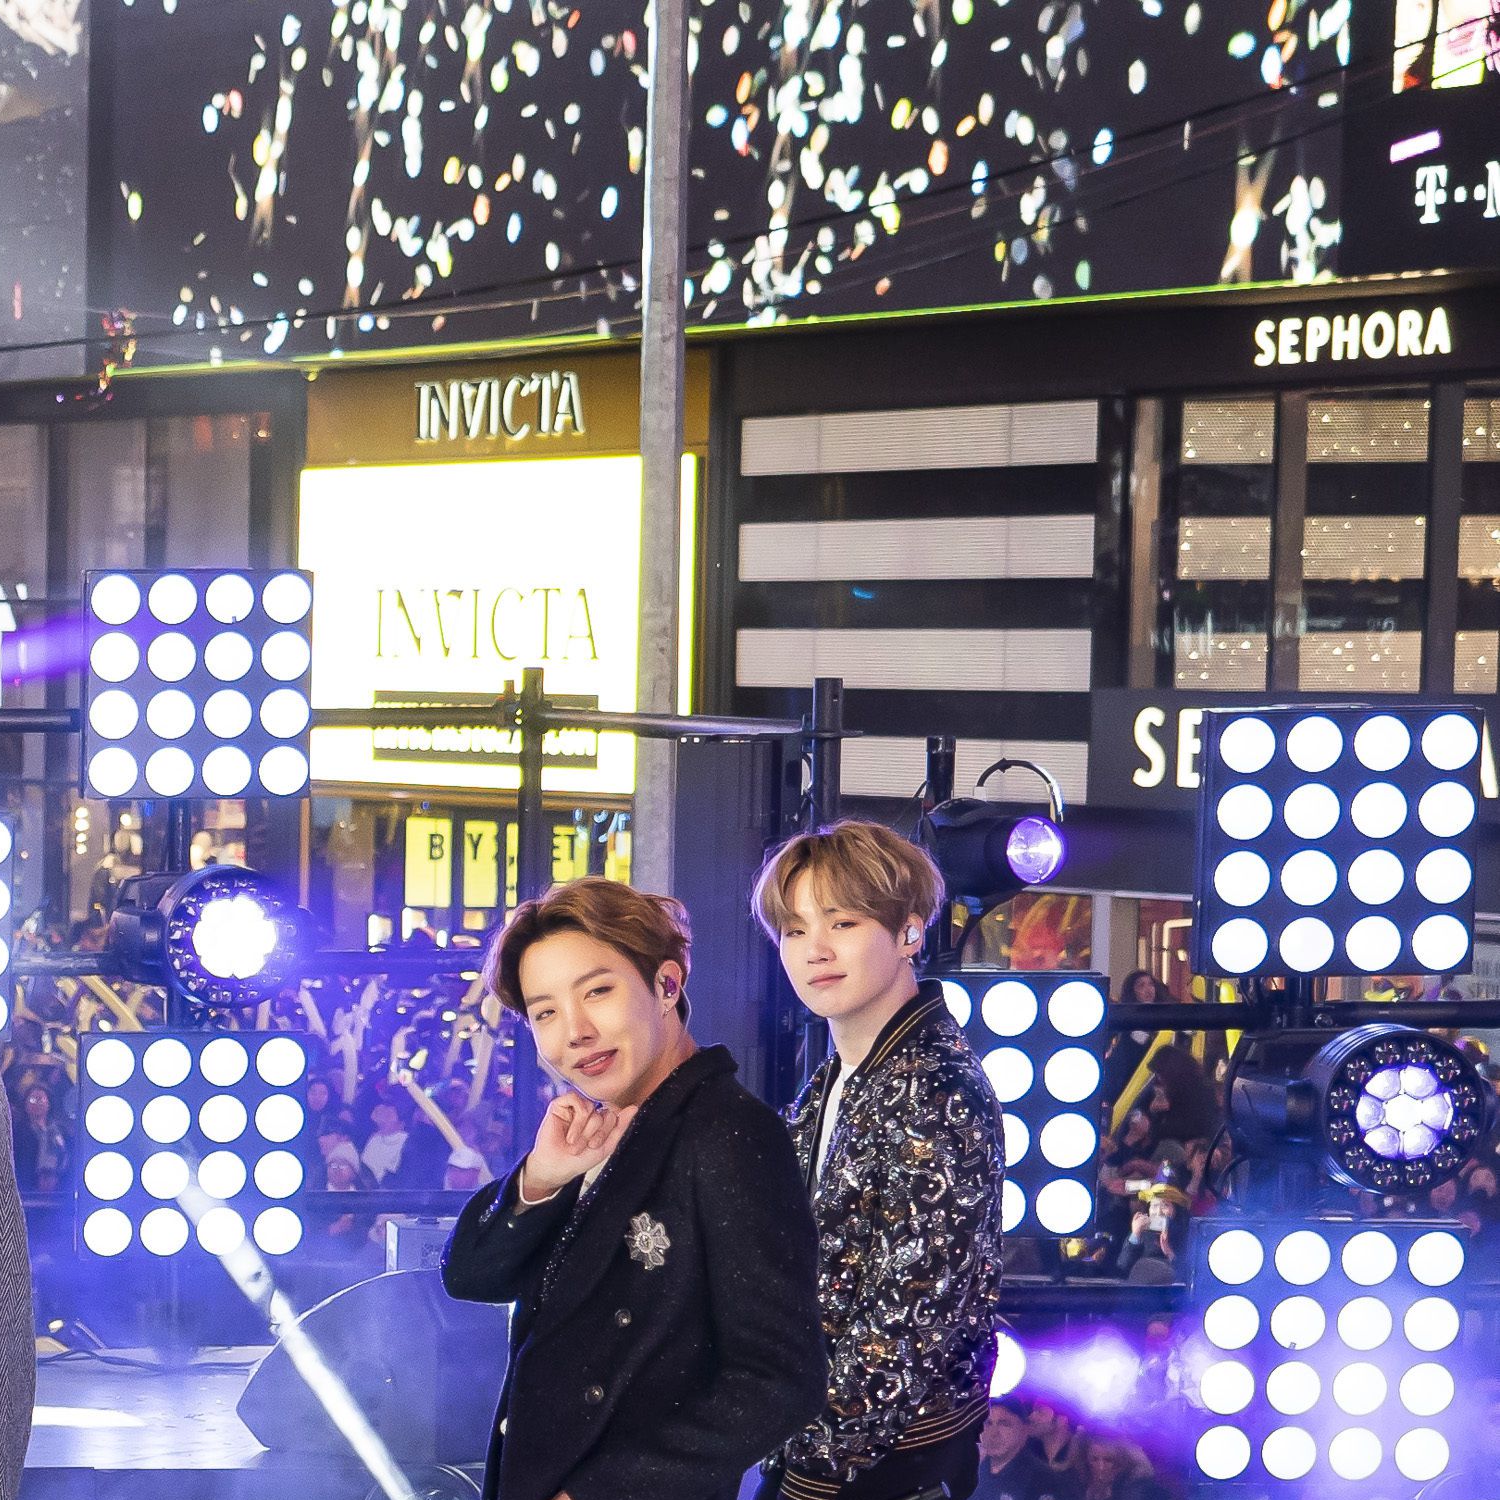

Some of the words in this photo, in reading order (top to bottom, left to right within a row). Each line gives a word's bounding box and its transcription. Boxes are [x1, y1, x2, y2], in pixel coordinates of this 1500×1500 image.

[1254, 306, 1452, 367] SEPHORA
[415, 371, 586, 442] INVICTA
[376, 588, 599, 660] INVICTA
